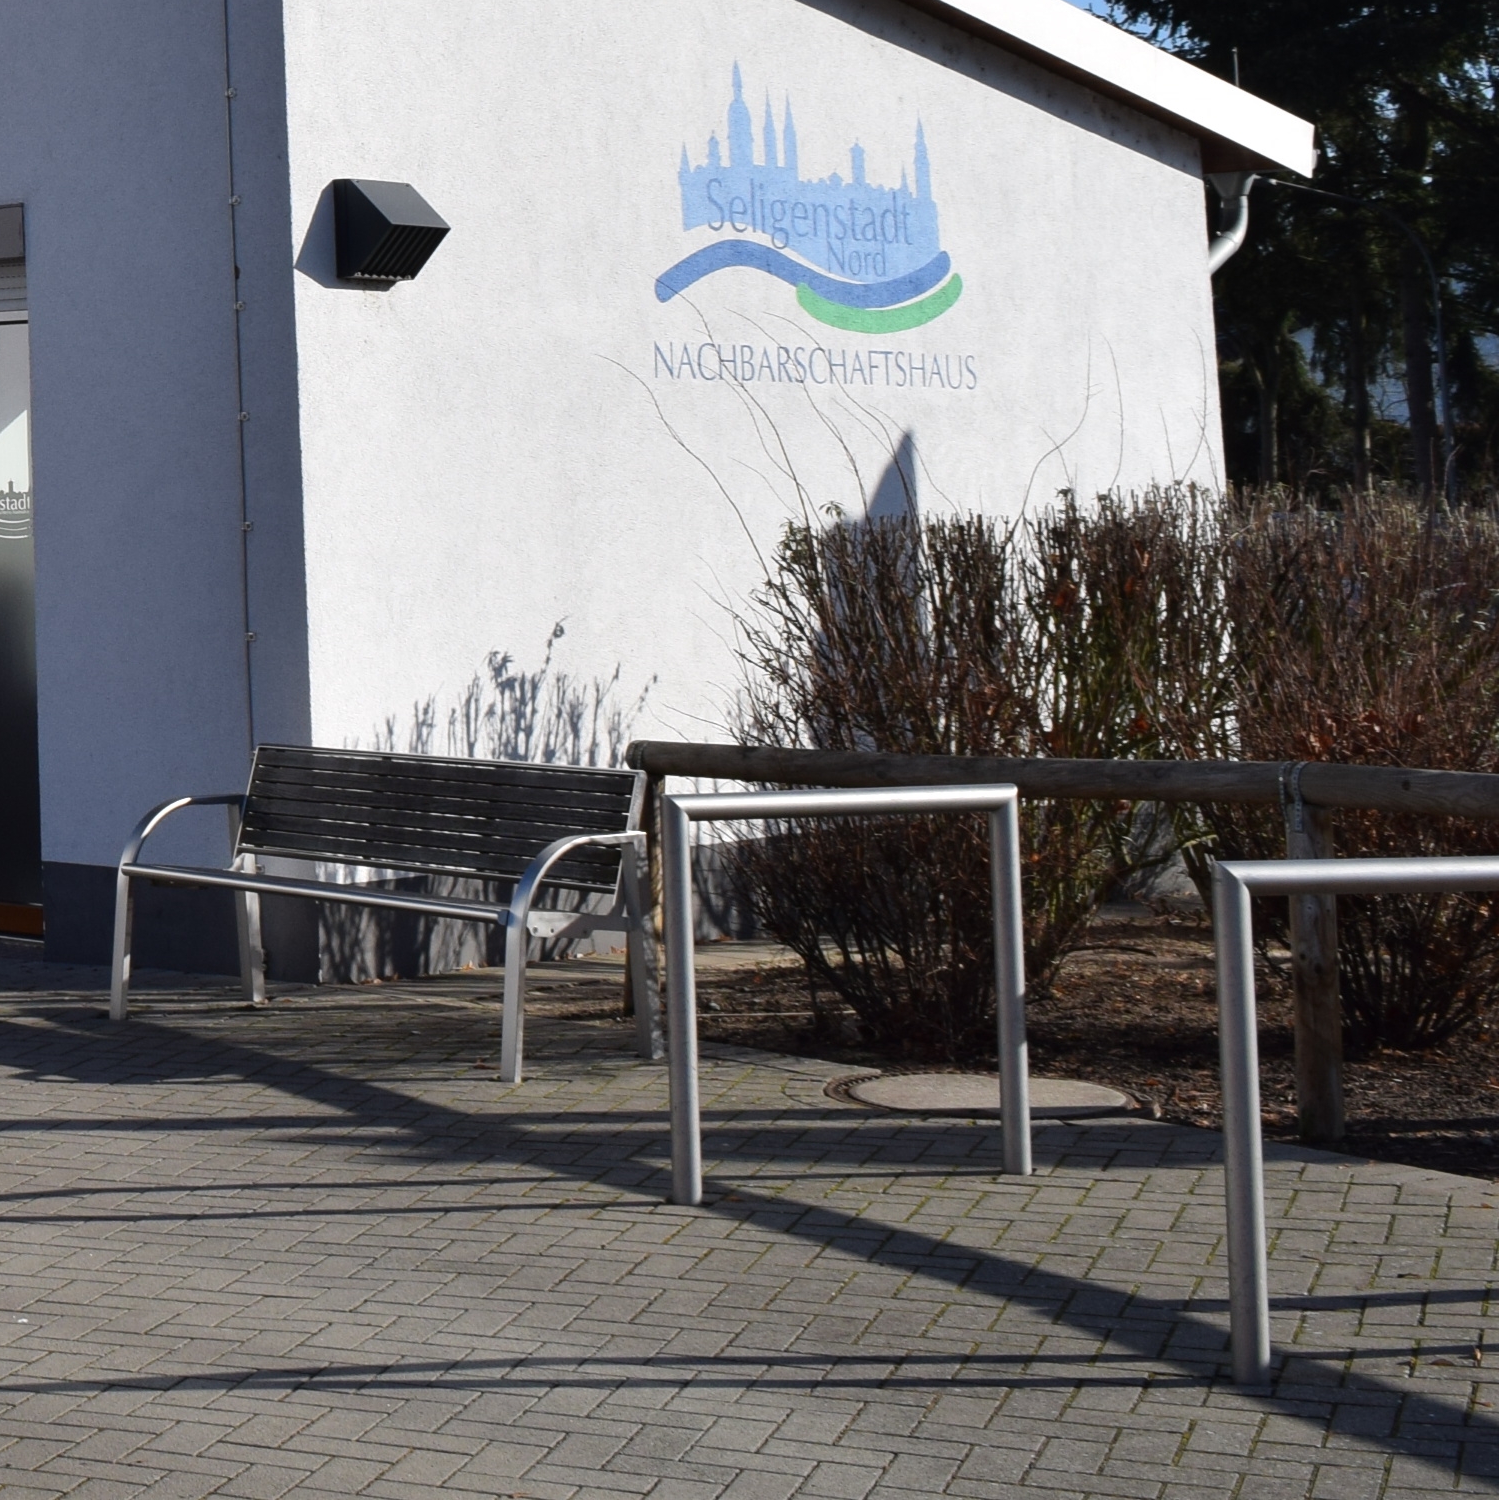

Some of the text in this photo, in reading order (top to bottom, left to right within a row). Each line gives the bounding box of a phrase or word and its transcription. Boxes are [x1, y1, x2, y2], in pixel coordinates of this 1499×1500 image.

[706, 177, 914, 250] Seligenstadt
[826, 240, 888, 278] Nord
[653, 340, 978, 391] NACHBARSCHAFTSHAUS
